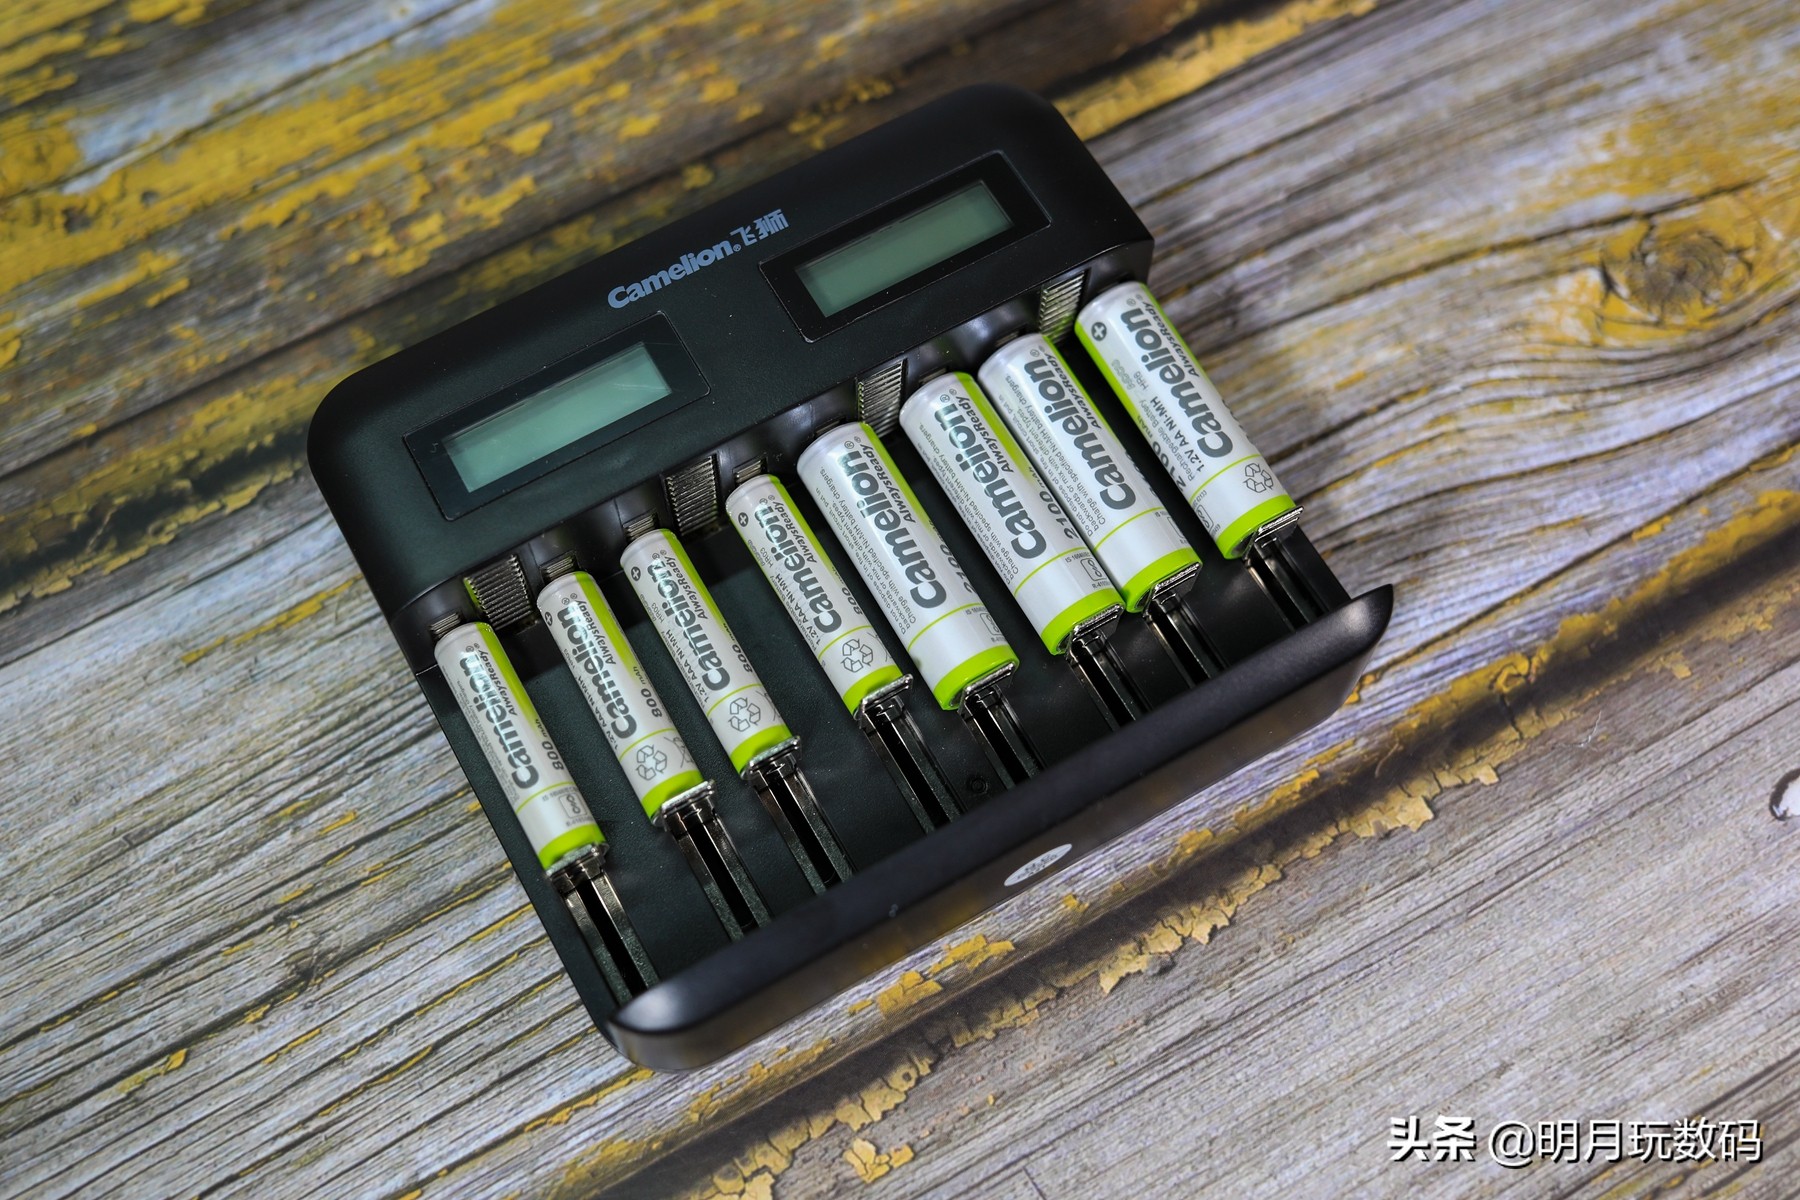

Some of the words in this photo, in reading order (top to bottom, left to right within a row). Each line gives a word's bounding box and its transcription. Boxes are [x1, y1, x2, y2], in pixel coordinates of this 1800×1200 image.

[608, 240, 733, 309] Camelion
[730, 208, 789, 247] 飞狮
[1140, 298, 1199, 379] AlwaysReady
[1042, 350, 1102, 431] AlwaysReady
[1113, 304, 1236, 464] Camelion
[1132, 370, 1149, 390] HR6
[1023, 404, 1044, 429] battery
[1137, 398, 1160, 428] Battery
[1149, 395, 1177, 430] Ni-MH
[916, 421, 942, 454] chargers.
[954, 392, 1014, 476] AlwaysReady
[1017, 354, 1138, 516] Camelion
[1025, 436, 1040, 455] short
[1027, 427, 1050, 456] different
[1039, 428, 1058, 452] Ni-MH
[1171, 429, 1189, 448] AA
[937, 453, 958, 478] battery
[1046, 455, 1059, 471] with
[1053, 451, 1079, 483] specified
[1149, 440, 1188, 491] 2100
[1155, 426, 1196, 481] Rechargeable
[1183, 447, 1206, 473] 1.2V
[816, 465, 842, 500] chargers.
[858, 440, 917, 526] AlwaysReady
[926, 401, 1050, 564] Camelion
[943, 475, 966, 505] different
[953, 477, 972, 501] Ni-MH
[1056, 470, 1069, 484] mix
[1074, 482, 1089, 498] with
[829, 500, 846, 522] types.
[836, 498, 857, 524] battery
[962, 504, 974, 519] with
[1057, 483, 1078, 511] dispose
[1071, 492, 1100, 530] backwards
[1084, 496, 1107, 525] Charge
[830, 446, 950, 614] Camelion
[968, 499, 993, 531] specified
[1038, 488, 1079, 542] 2100
[771, 498, 818, 565] AlwaysReady
[840, 530, 855, 550] short
[842, 522, 863, 551] different
[852, 524, 870, 548] Ni-MH
[989, 531, 1003, 547] with
[748, 503, 845, 637] Camelion
[860, 551, 872, 566] with
[865, 547, 891, 580] specified
[986, 541, 1015, 580] backwards
[998, 546, 1021, 574] Charge
[662, 552, 709, 622] AlwaysReady
[774, 573, 796, 602] Ni-MH
[871, 580, 892, 609] dispose
[886, 579, 901, 597] with
[792, 602, 808, 623] AAA
[883, 589, 911, 629] backwards
[895, 594, 918, 624] Charge
[573, 595, 617, 667] AlwaysReady
[641, 559, 733, 694] Camelion
[806, 624, 822, 645] 1.2V
[664, 628, 685, 659] Ni-MH
[731, 642, 753, 674] 800
[476, 647, 519, 717] AlwaysReady
[551, 604, 640, 741] Camelion
[632, 665, 646, 685] mAh
[681, 659, 697, 681] AAA
[639, 686, 663, 719] 800
[694, 682, 710, 703] 1.2V
[453, 652, 542, 792] Camelion
[605, 729, 619, 749] 1.2V
[540, 738, 564, 773] 800
